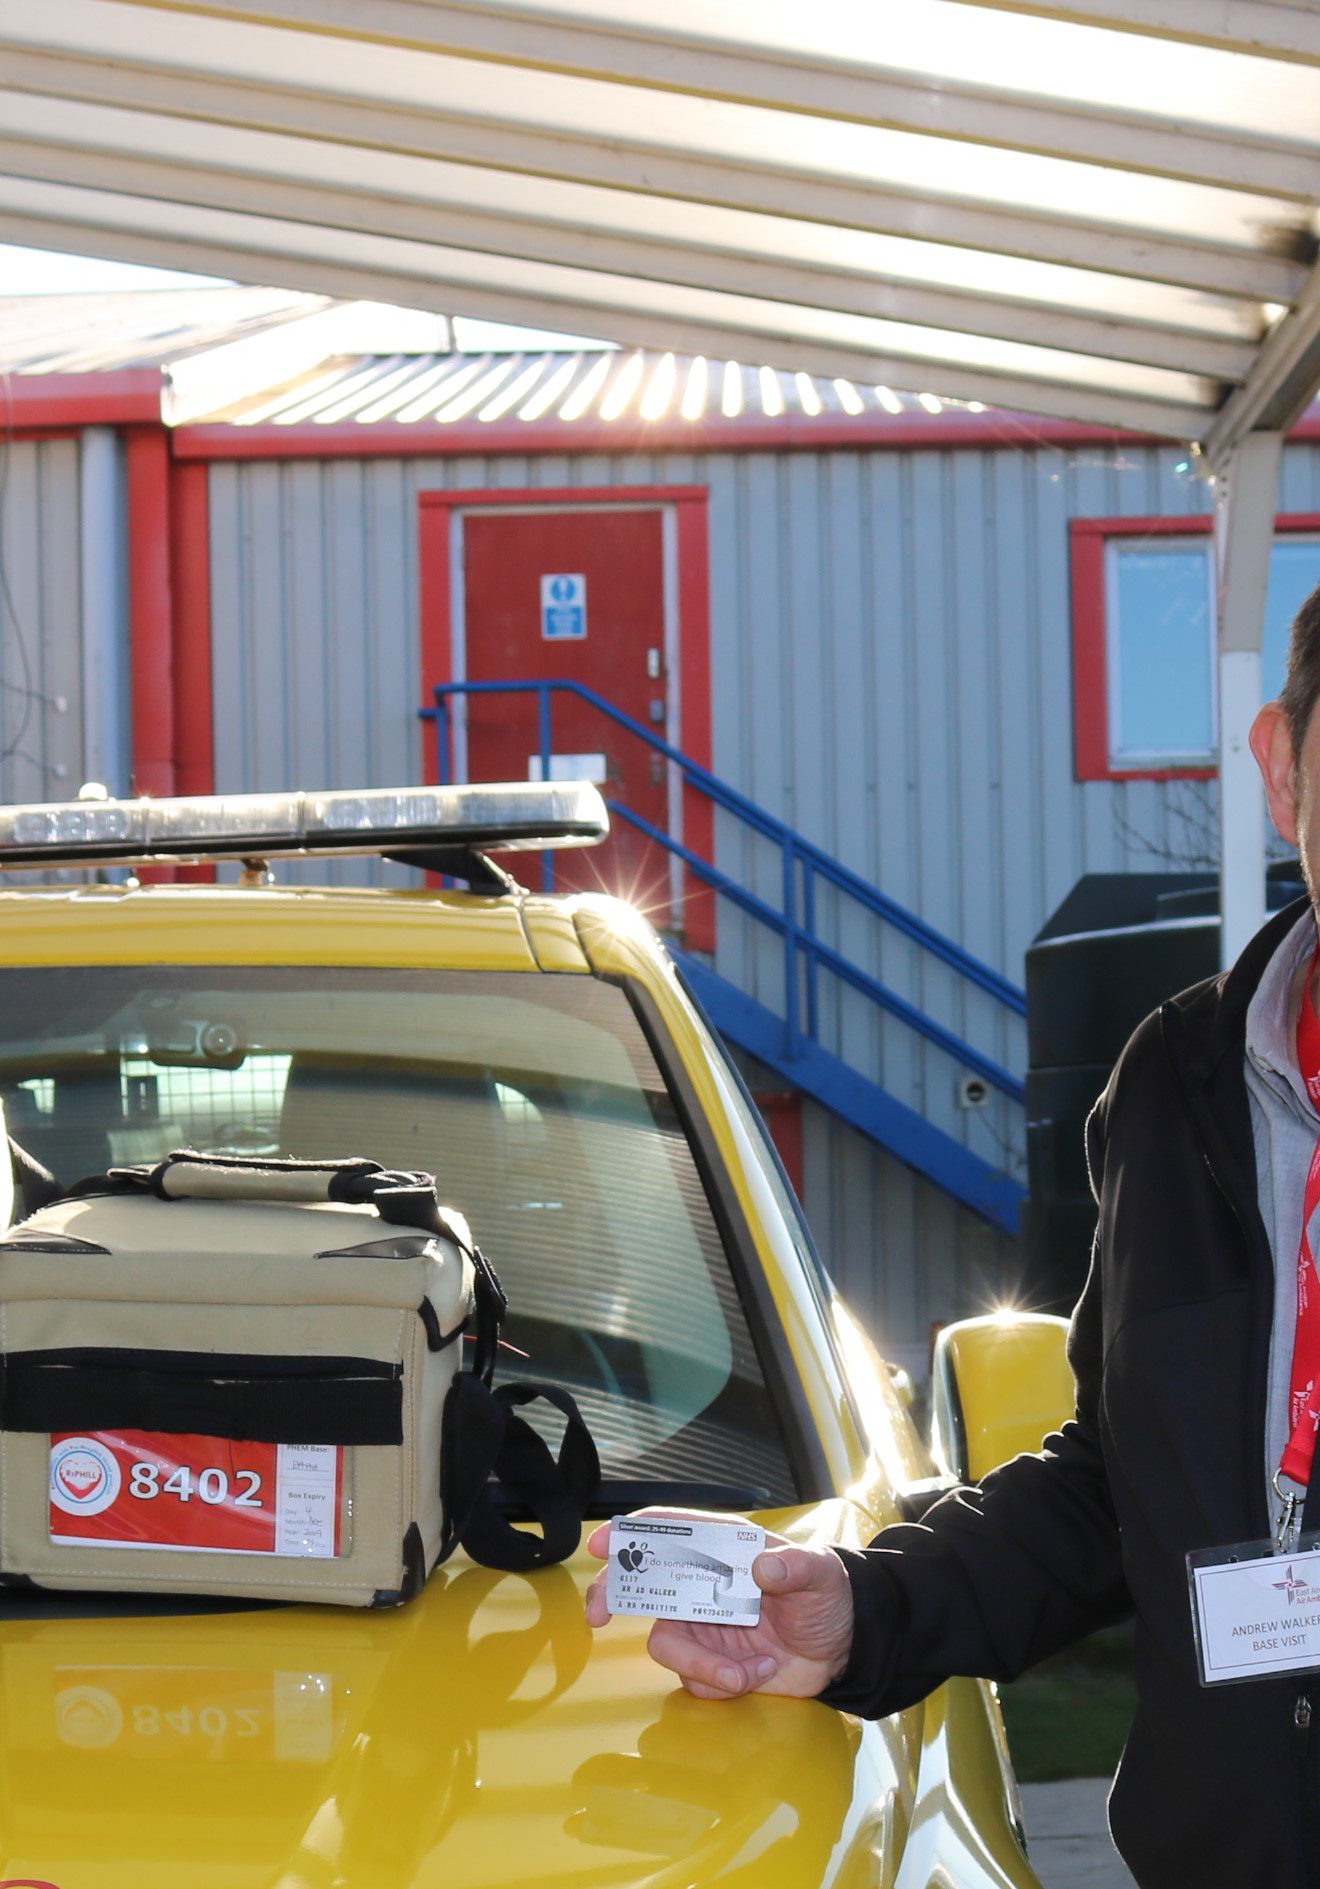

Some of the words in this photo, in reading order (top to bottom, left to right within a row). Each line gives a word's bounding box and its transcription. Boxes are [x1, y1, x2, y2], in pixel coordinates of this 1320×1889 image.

[129, 1462, 263, 1507] 8402
[304, 1492, 326, 1501] Expiry
[737, 1532, 757, 1541] NHS
[650, 1558, 661, 1566] do
[664, 1560, 709, 1572] something
[711, 1563, 749, 1575] amazing
[676, 1573, 693, 1582] give
[696, 1572, 721, 1583] blood
[649, 1587, 677, 1596] WALKER
[1296, 1588, 1310, 1596] East
[641, 1603, 677, 1612] POSITIVE
[1232, 1621, 1278, 1636] ANDREW
[1253, 1638, 1278, 1651] BASE
[1281, 1634, 1306, 1647] VISIT
